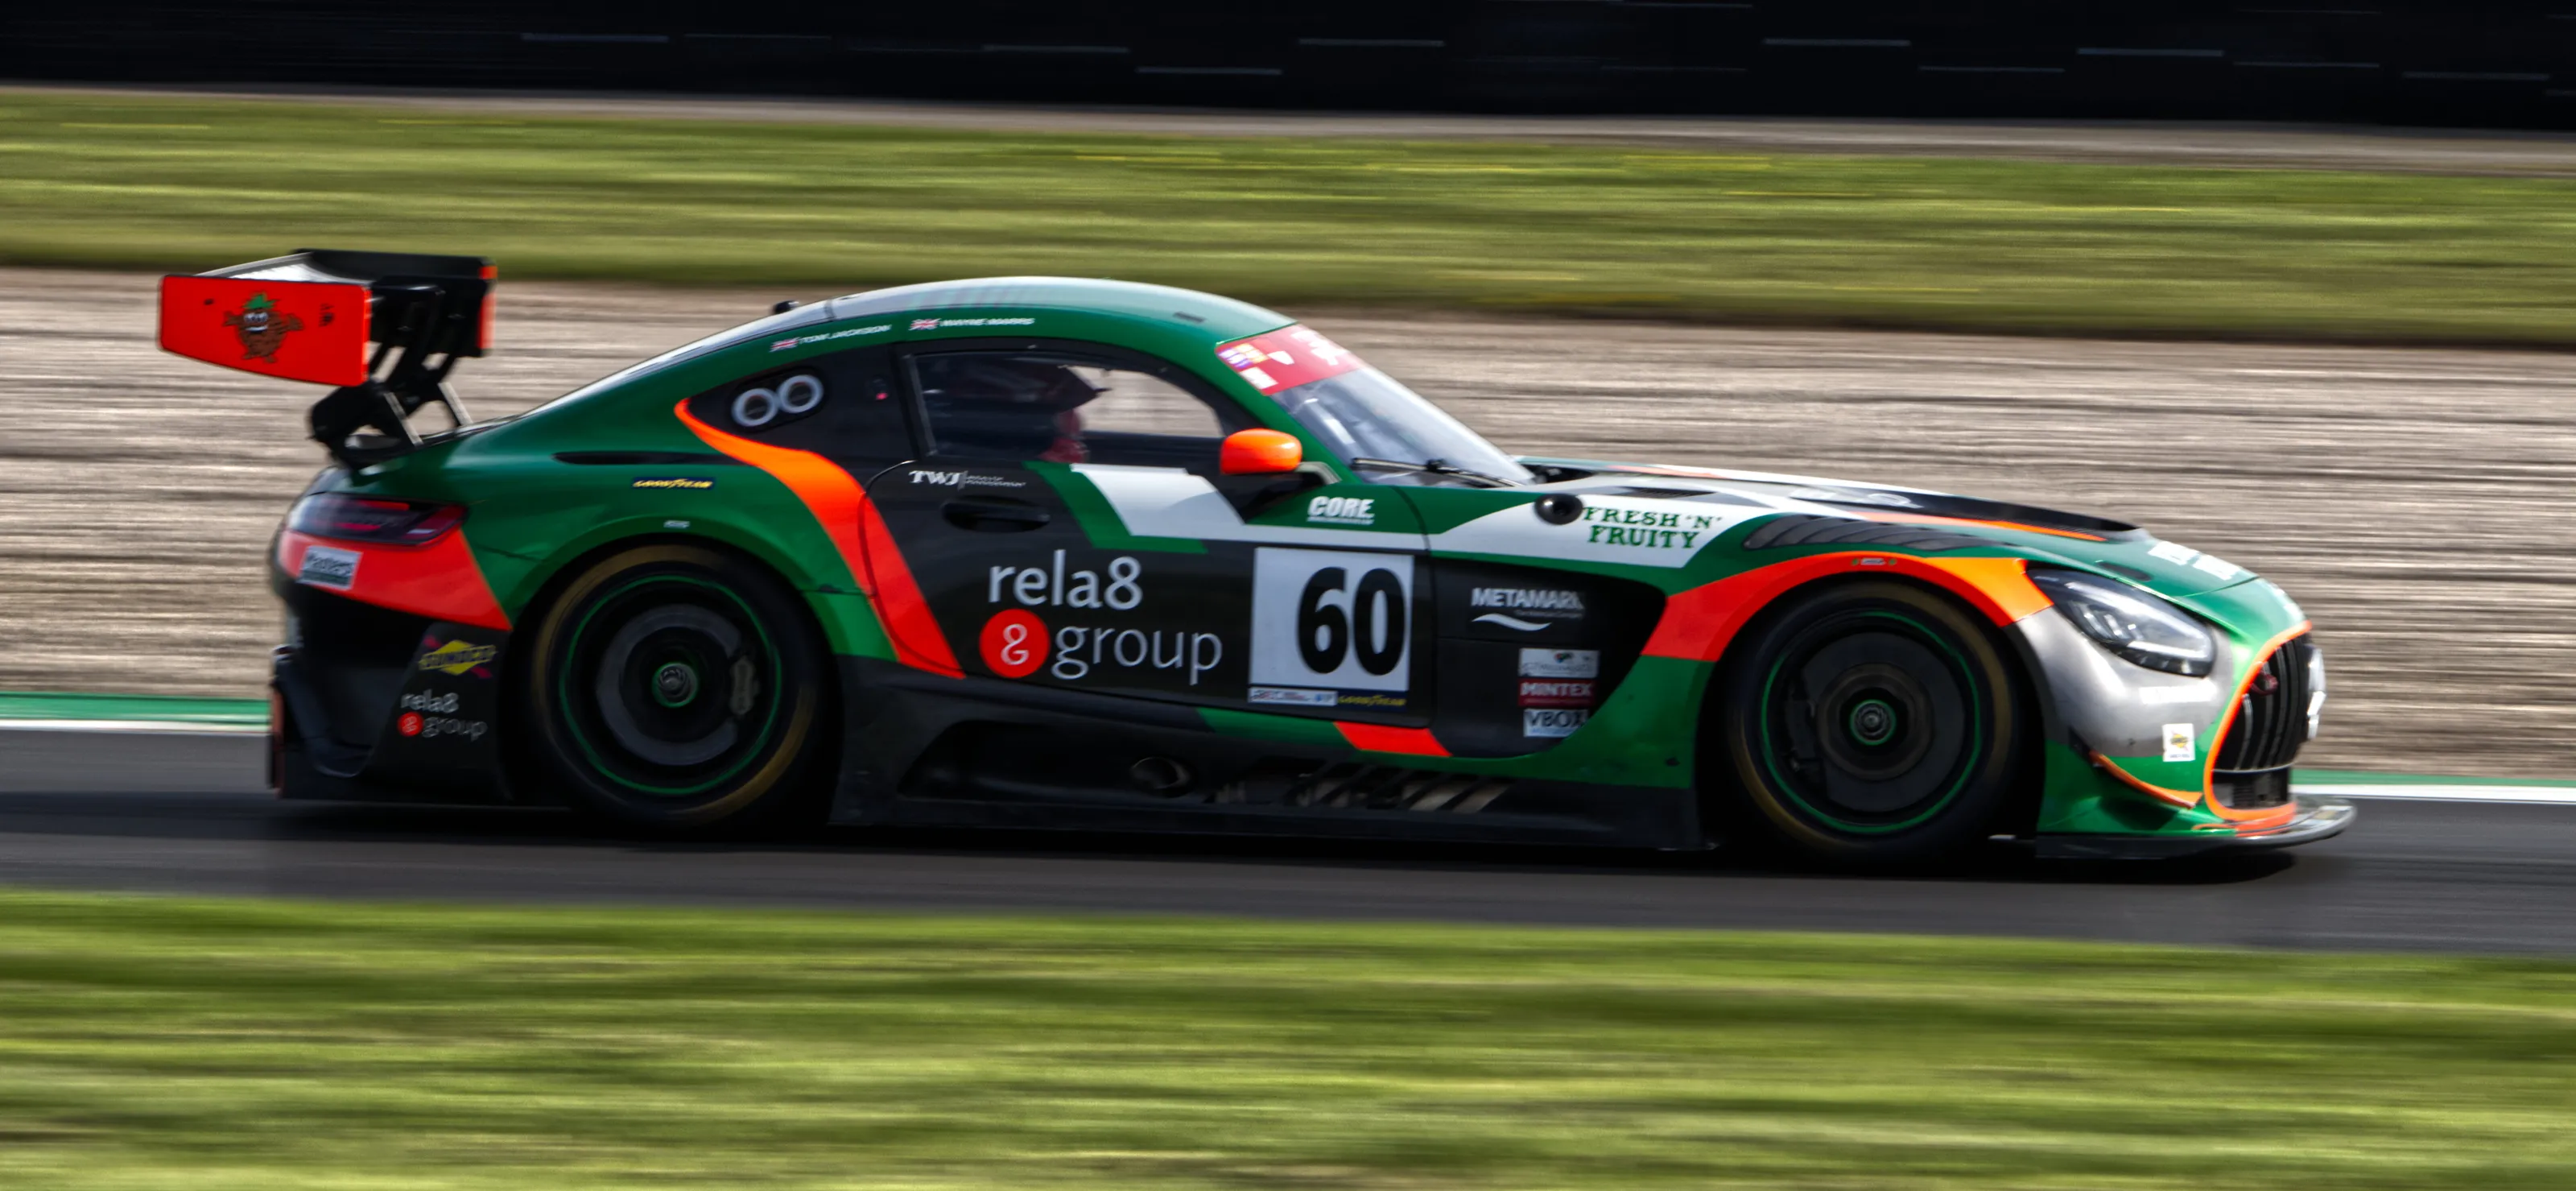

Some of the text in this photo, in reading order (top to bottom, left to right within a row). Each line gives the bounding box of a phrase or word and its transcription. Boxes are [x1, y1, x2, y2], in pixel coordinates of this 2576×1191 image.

[908, 470, 962, 486] TWJ
[1307, 495, 1375, 519] CORE
[1583, 507, 1682, 527] FRESH
[1588, 525, 1700, 548] FRUITY
[989, 548, 1143, 610] rela8
[1296, 566, 1406, 676] 60
[1051, 626, 1223, 685] group
[401, 689, 459, 713] rela8
[1520, 681, 1593, 697] MINTEX
[423, 716, 488, 742] group
[1528, 709, 1587, 728] VBOX
